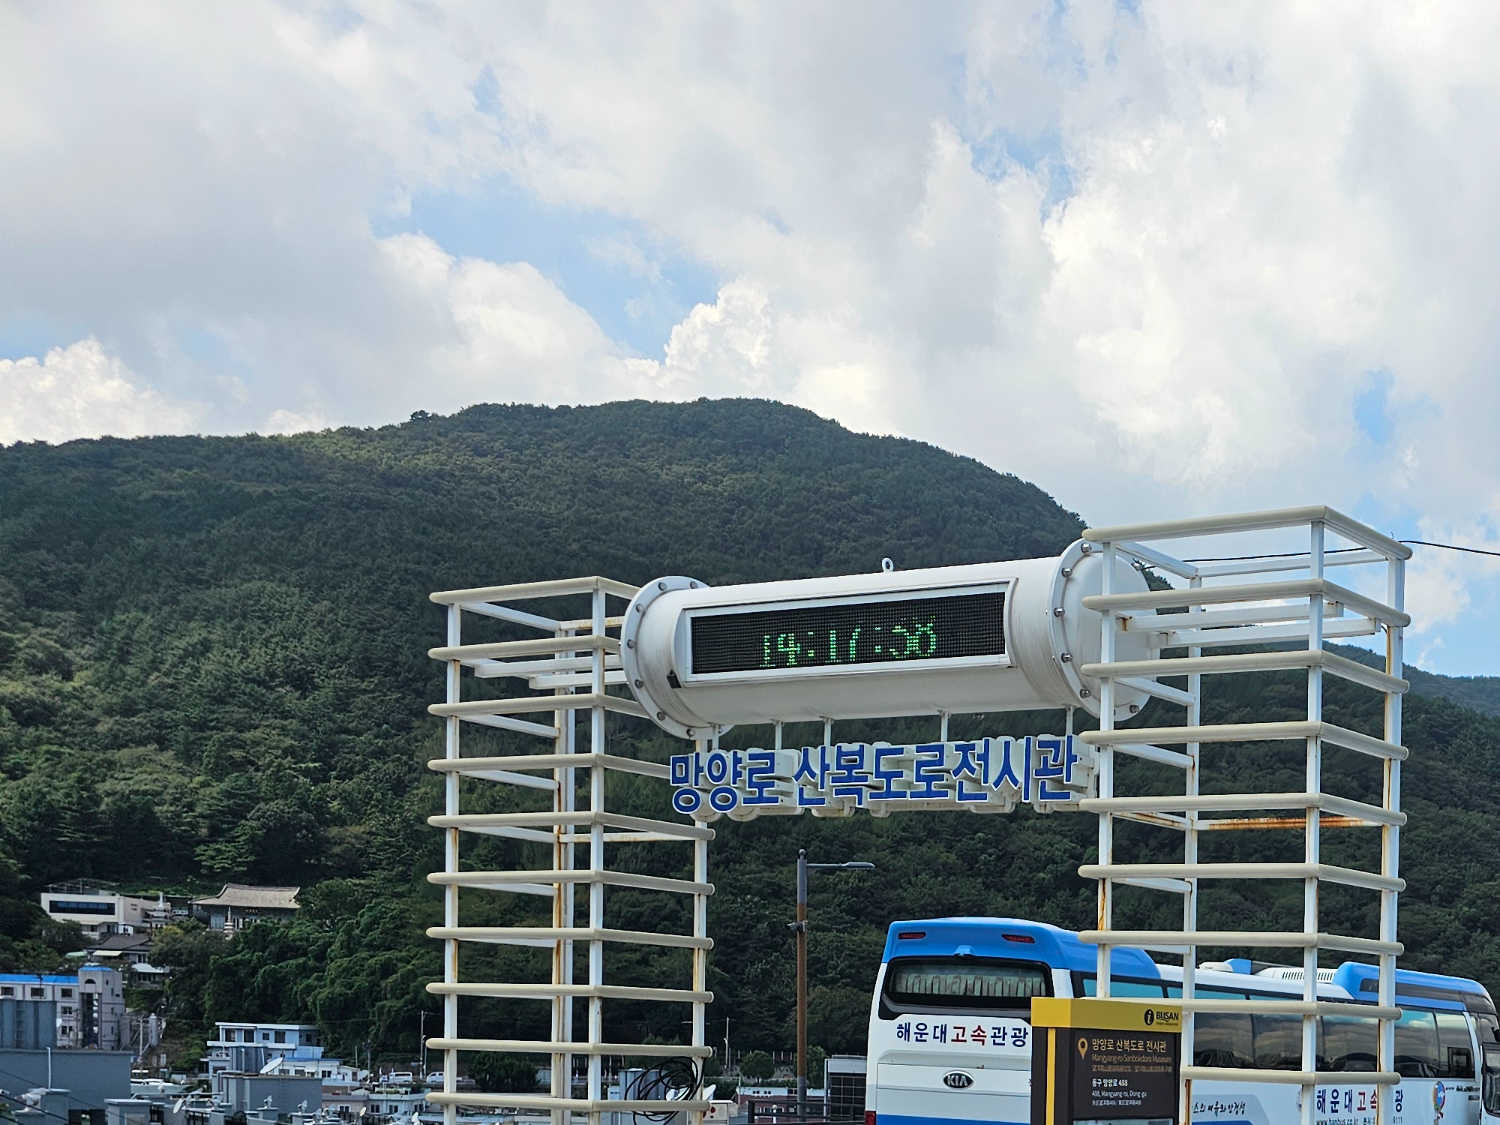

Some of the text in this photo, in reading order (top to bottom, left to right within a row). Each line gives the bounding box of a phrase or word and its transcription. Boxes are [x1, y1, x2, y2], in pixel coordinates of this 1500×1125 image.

[670, 751, 779, 815] 망양로
[1156, 1011, 1179, 1021] BUSAN
[896, 1022, 1028, 1047] 해운대고속관광
[1092, 1038, 1167, 1053] 망양로 산복도로 전시관
[947, 1075, 968, 1087] KIA
